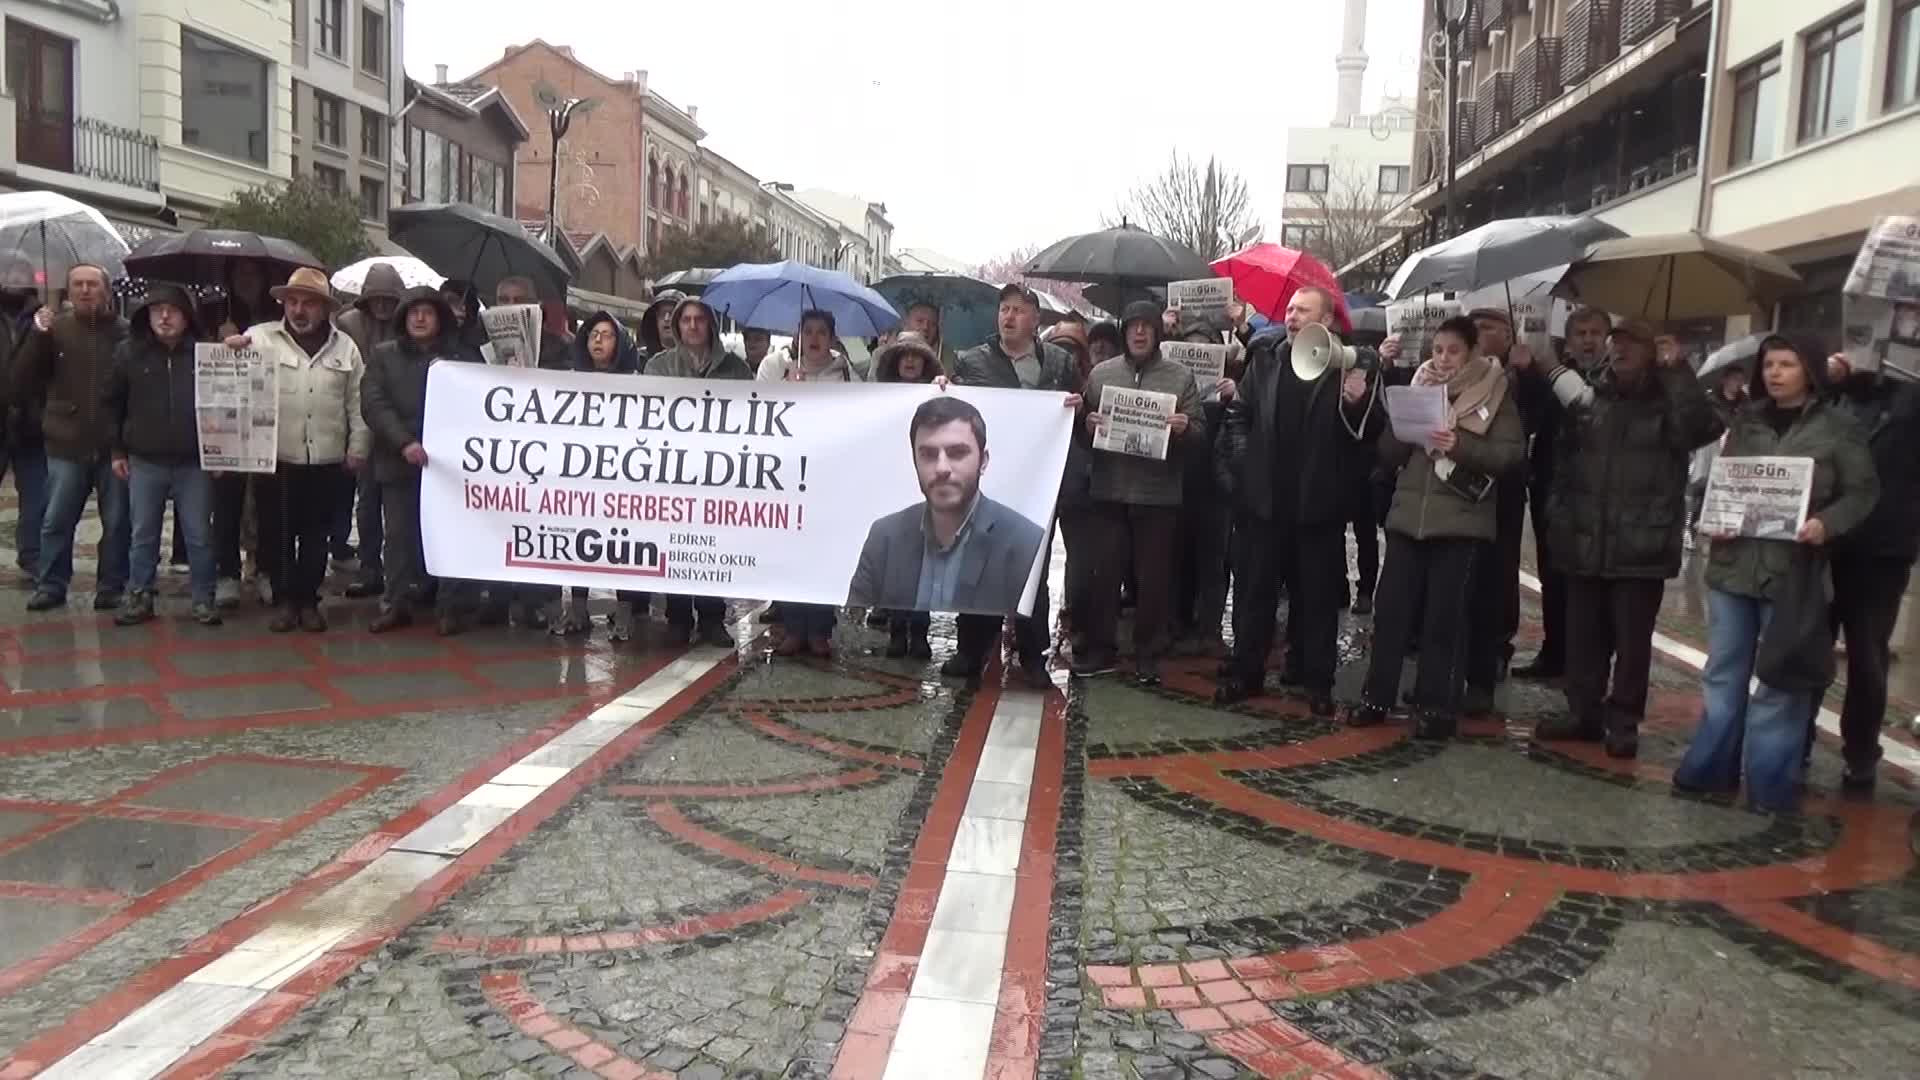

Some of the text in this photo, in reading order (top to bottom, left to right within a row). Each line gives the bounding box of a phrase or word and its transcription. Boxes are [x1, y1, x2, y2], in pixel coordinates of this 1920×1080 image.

[484, 385, 796, 437] GAZETECİLİK
[462, 436, 807, 492] SUÇ DEĞİLDİR !
[464, 479, 531, 513] İSMAİL
[603, 493, 696, 524] SERBEST
[703, 499, 789, 530] BIRAKIN
[797, 504, 803, 531] !
[668, 550, 756, 567] BİRGÜN OKUR
[669, 532, 717, 547] EDİRNE
